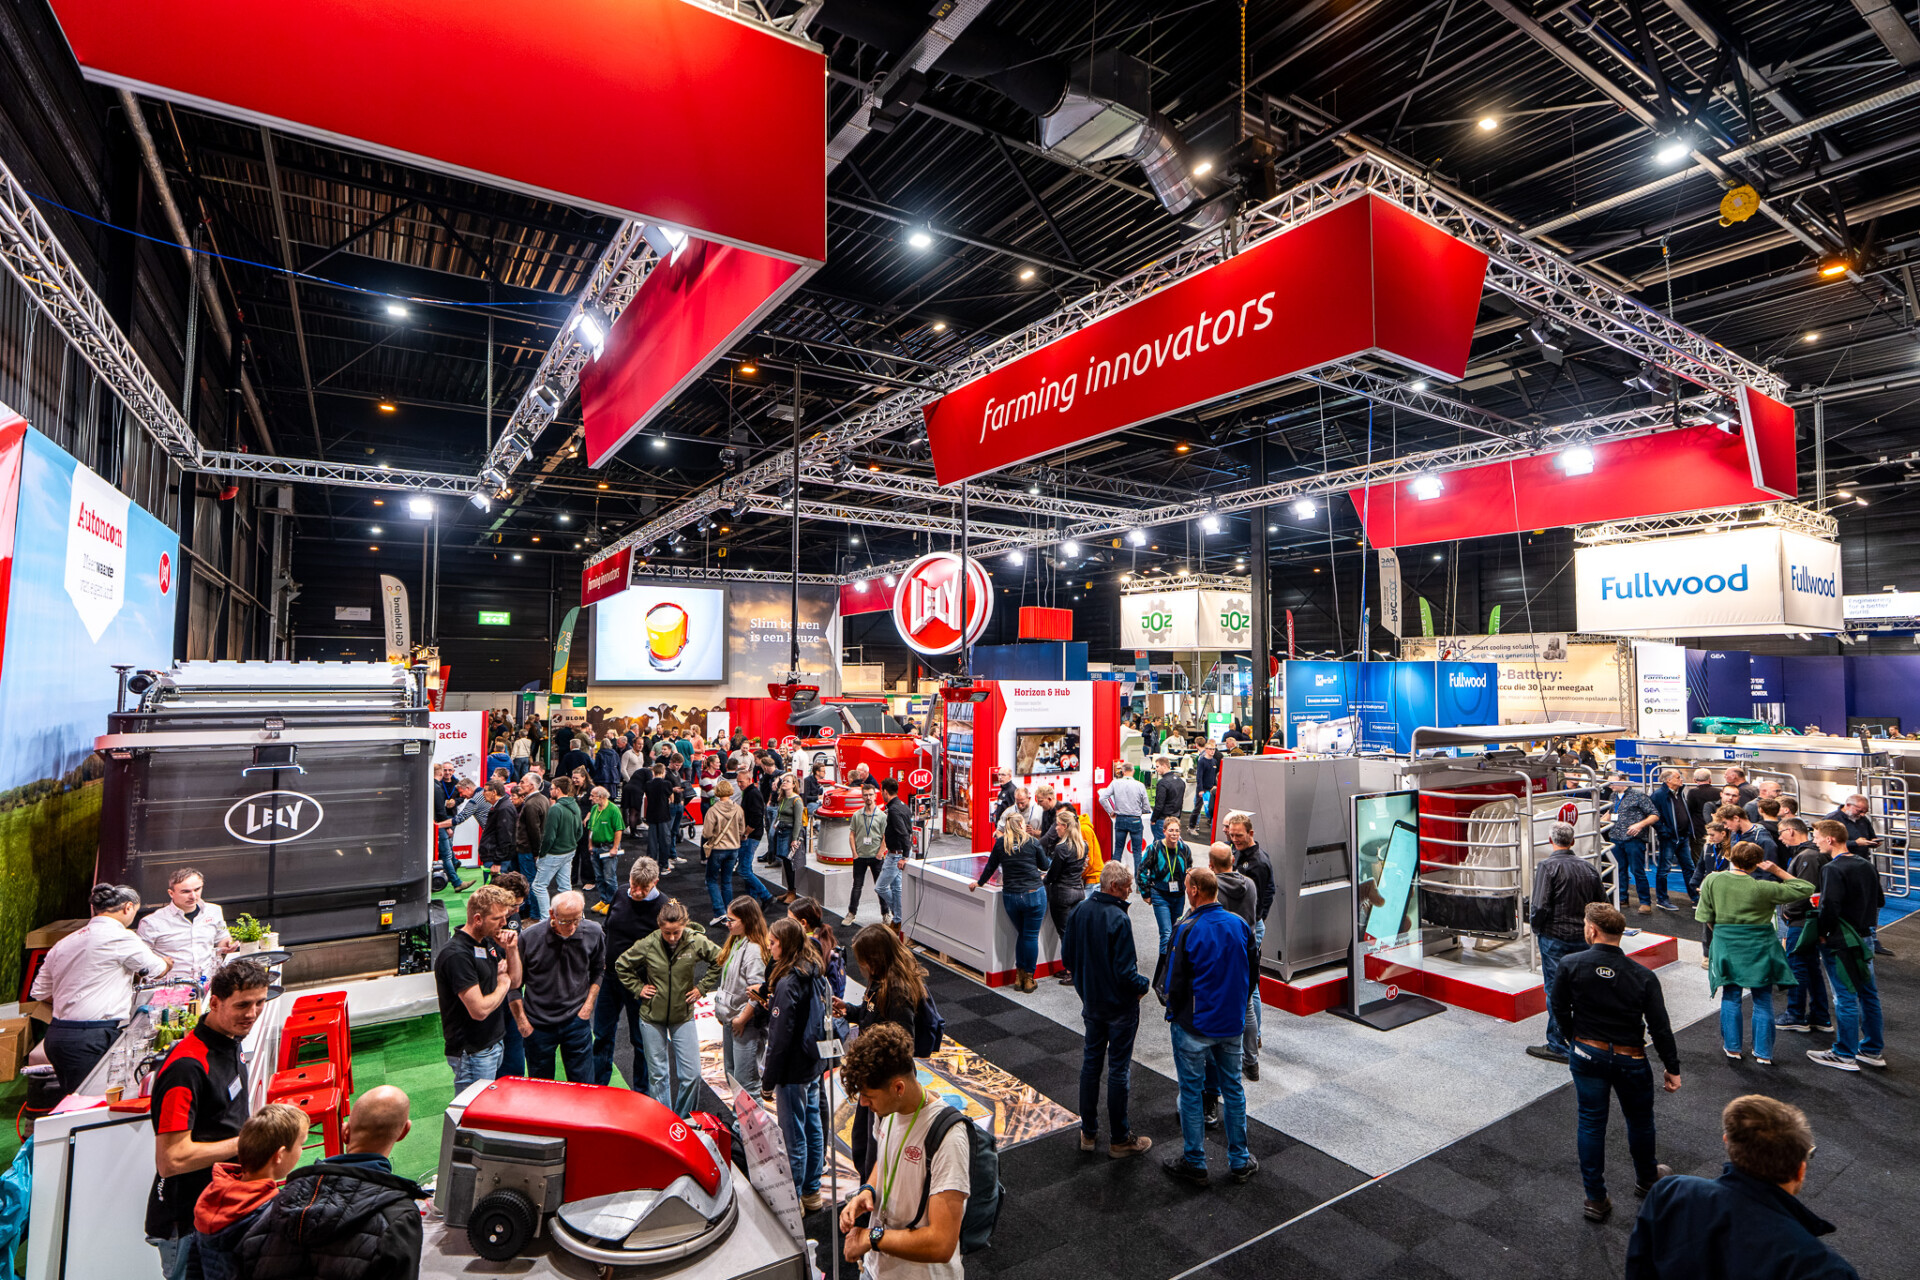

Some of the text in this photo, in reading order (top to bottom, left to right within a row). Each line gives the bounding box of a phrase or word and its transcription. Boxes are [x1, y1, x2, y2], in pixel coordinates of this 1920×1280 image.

[979, 291, 1276, 443] farming innovators
[587, 567, 620, 594] farming innovators
[1601, 563, 1749, 600] Fullwood
[1791, 565, 1836, 598] Fullwood
[910, 568, 962, 635] LELY
[750, 618, 777, 629] Slim
[1141, 612, 1172, 631] JOZ
[1220, 611, 1250, 631] JOZ
[563, 631, 572, 653] KVIA
[750, 631, 760, 642] is
[763, 634, 784, 642] een
[1438, 640, 1467, 650] PAC
[1449, 673, 1487, 688] Fullwood
[1514, 683, 1526, 691] die
[1528, 683, 1538, 691] 30
[1557, 684, 1594, 693] meegaat
[1014, 687, 1071, 696] Horizon & Hub
[438, 729, 467, 739] actie
[1724, 750, 1753, 759] Merlin
[246, 799, 304, 835] LELY
